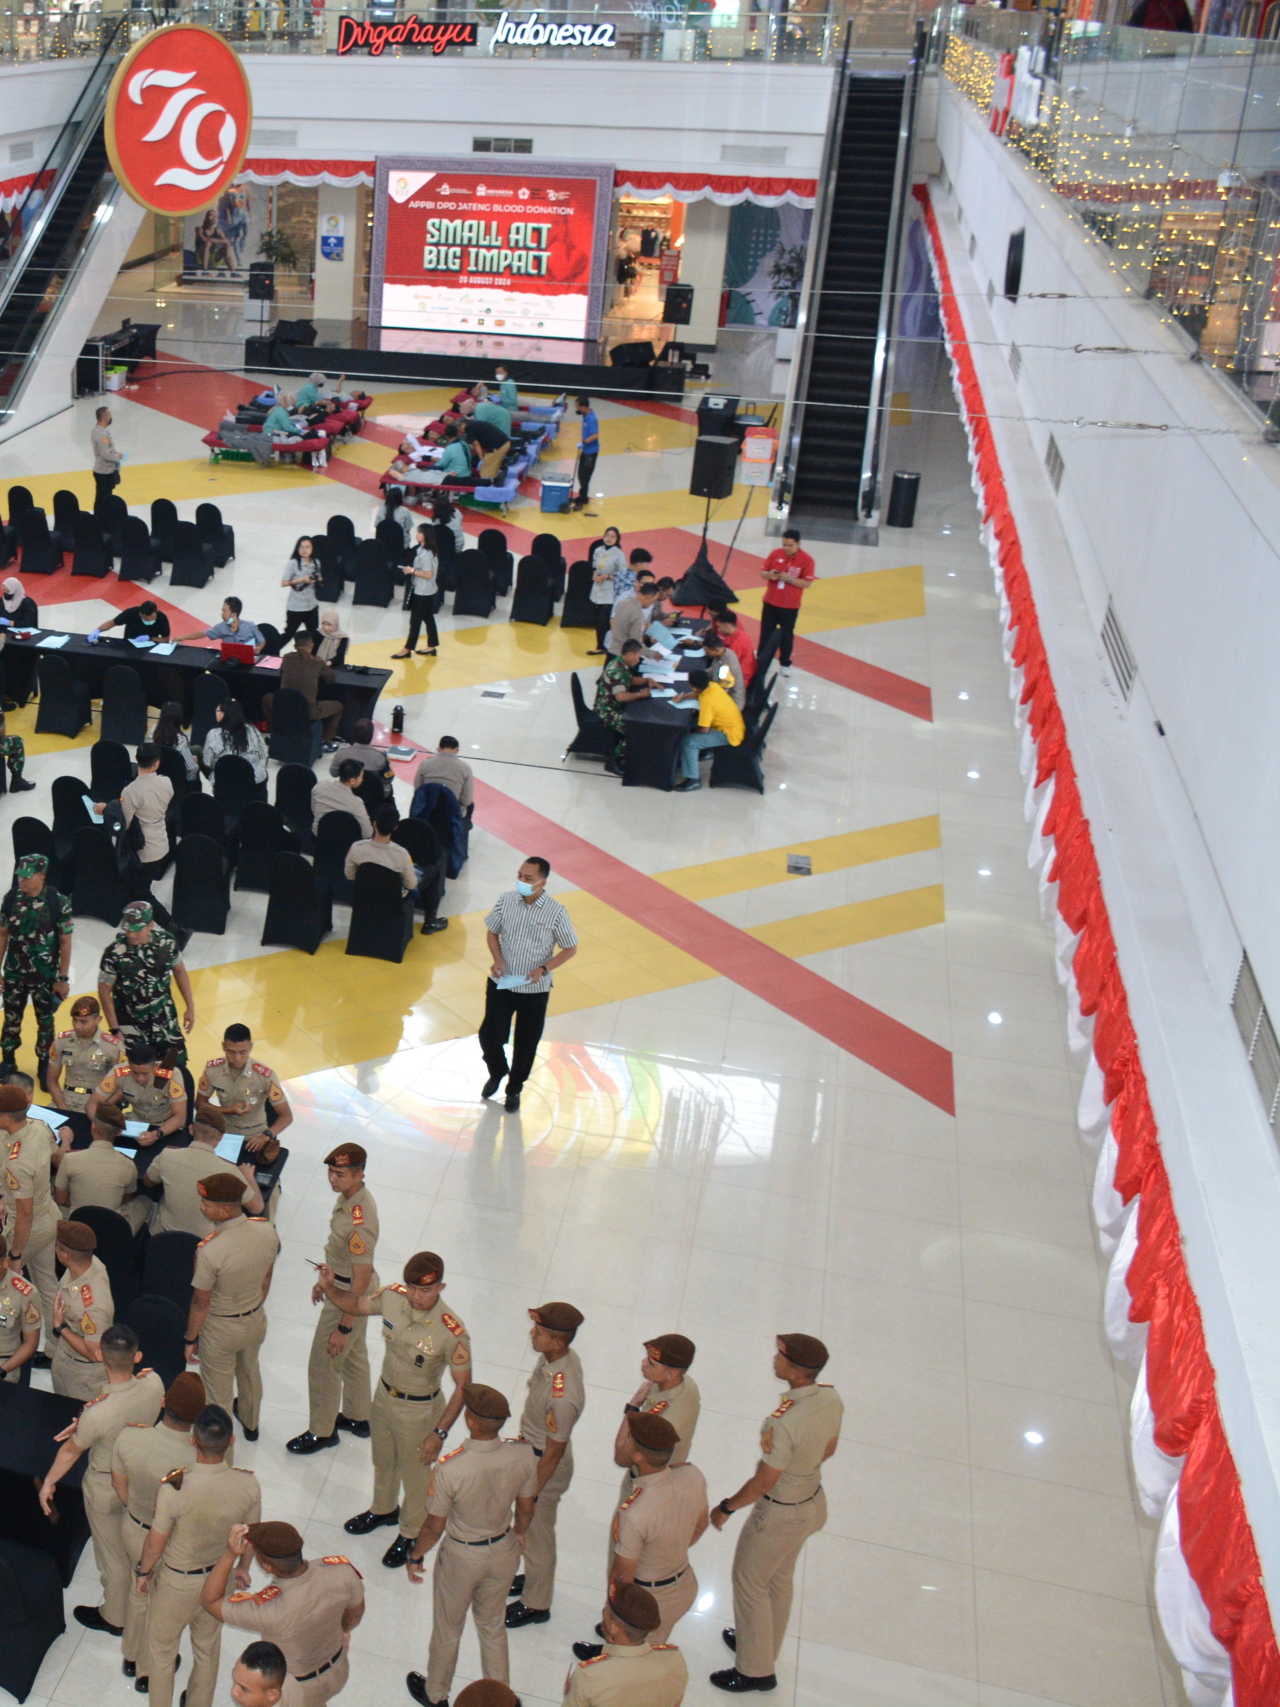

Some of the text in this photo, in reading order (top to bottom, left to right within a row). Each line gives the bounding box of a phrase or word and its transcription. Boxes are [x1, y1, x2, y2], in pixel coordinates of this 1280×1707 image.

[339, 12, 615, 56] Dirgahayu Indonesia
[127, 68, 237, 191] 79
[408, 200, 575, 216] APPBI DPD JATENG BLOOD DONATION
[425, 218, 553, 250] SMALL ACT
[423, 245, 552, 276] BIG IMPACT
[469, 276, 493, 285] AUGUST
